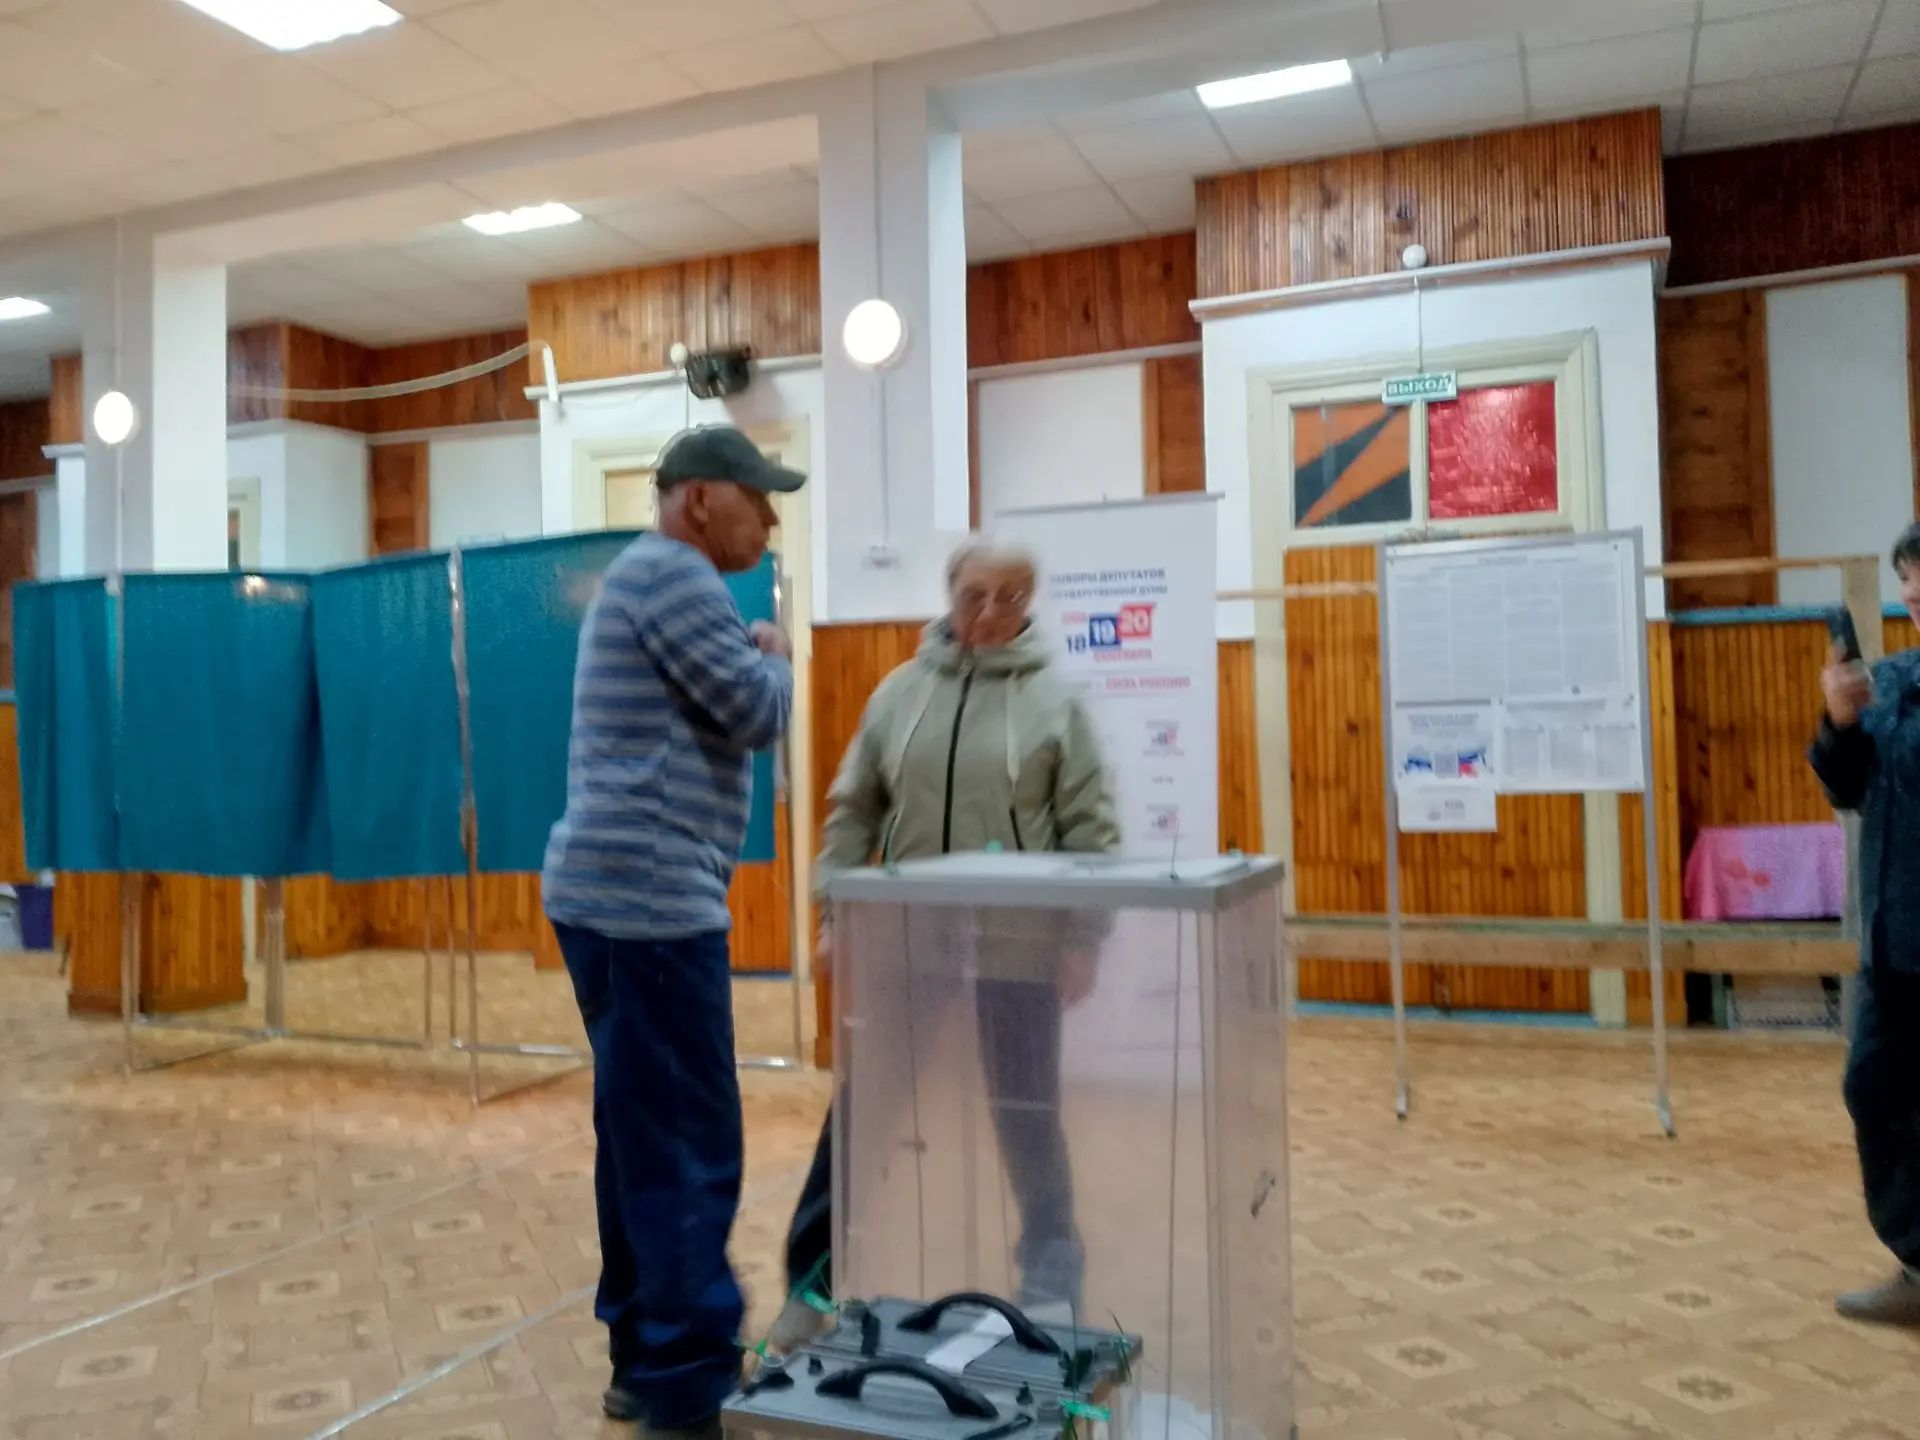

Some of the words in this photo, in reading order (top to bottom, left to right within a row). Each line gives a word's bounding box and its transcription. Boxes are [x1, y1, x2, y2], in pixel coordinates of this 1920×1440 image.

[1388, 378, 1450, 396] ВЫХОД
[1067, 634, 1087, 655] 18
[1092, 618, 1117, 645] 19
[1119, 608, 1149, 636] 20
